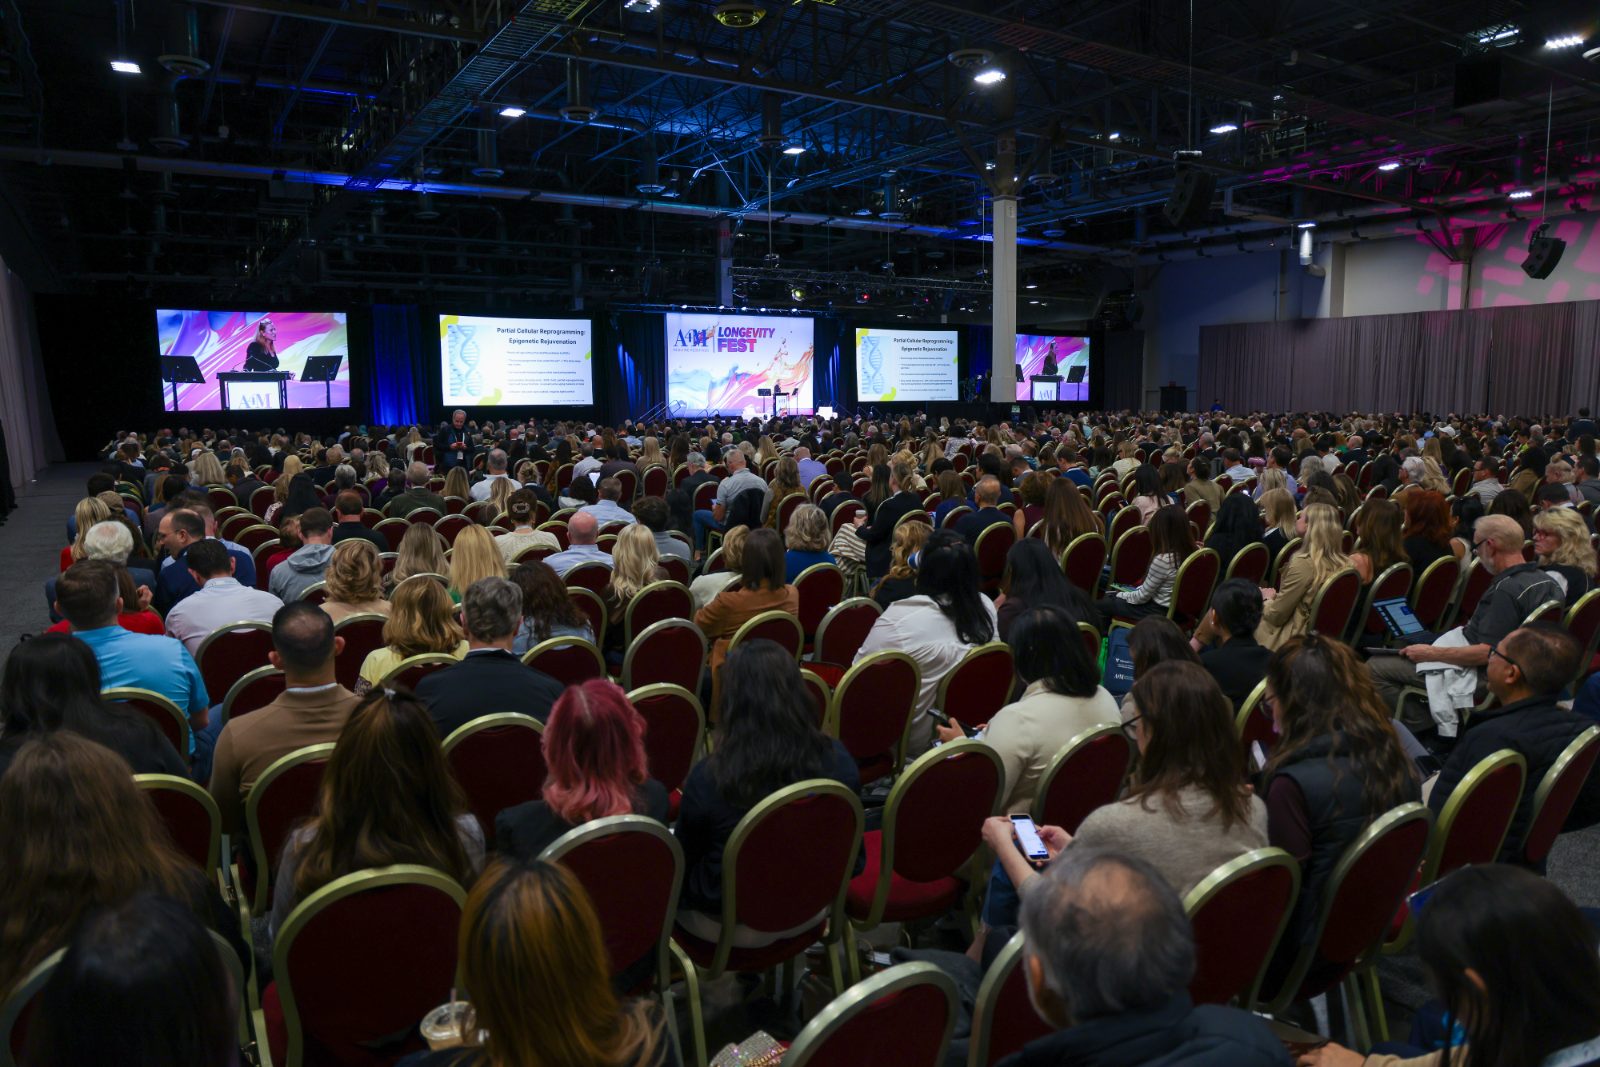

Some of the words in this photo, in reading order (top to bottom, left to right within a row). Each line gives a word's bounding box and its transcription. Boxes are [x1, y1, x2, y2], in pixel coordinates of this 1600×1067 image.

[540, 328, 586, 336] Reprogramming:
[718, 327, 775, 338] LONGEVITY
[540, 338, 577, 346] Rejuvenation
[717, 338, 757, 352] FEST
